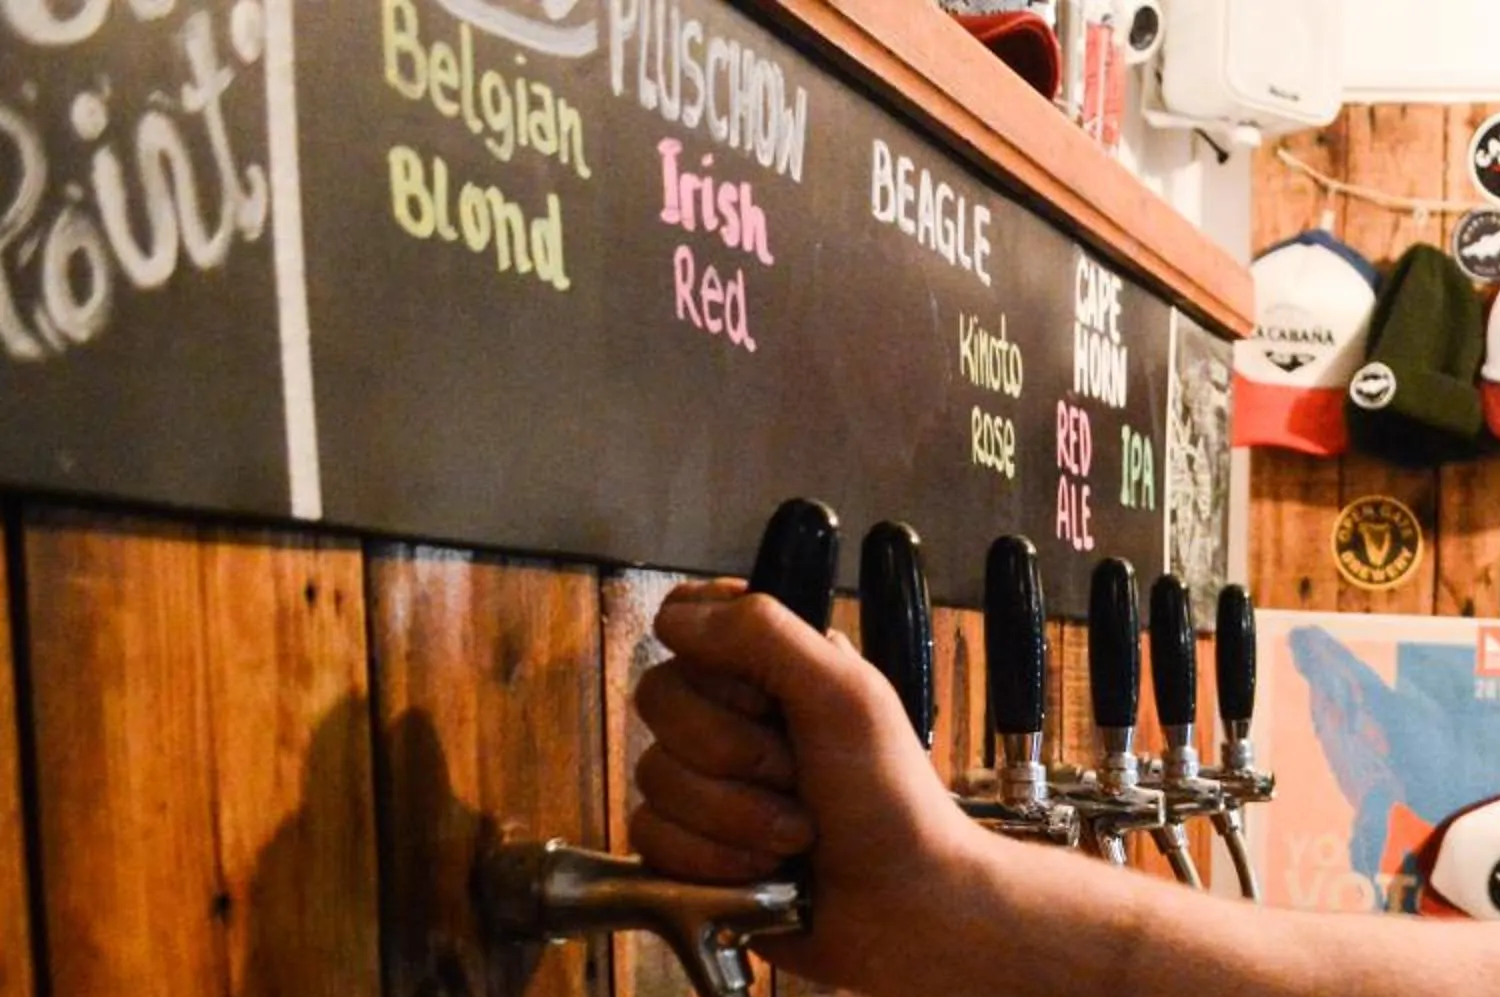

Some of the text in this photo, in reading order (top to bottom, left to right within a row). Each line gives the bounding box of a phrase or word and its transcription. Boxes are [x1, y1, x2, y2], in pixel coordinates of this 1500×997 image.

[384, 0, 592, 180] Belgian
[608, 0, 807, 183] PLUSCHOW
[388, 145, 571, 291] Blond
[657, 136, 775, 266] Irish
[871, 138, 992, 288] BEAGLE
[673, 244, 757, 353] Red
[1074, 250, 1123, 346] CAPE
[1072, 320, 1128, 409] HORN
[1056, 399, 1093, 478] RED
[1120, 423, 1156, 512] IPA
[1056, 474, 1095, 551] ALE
